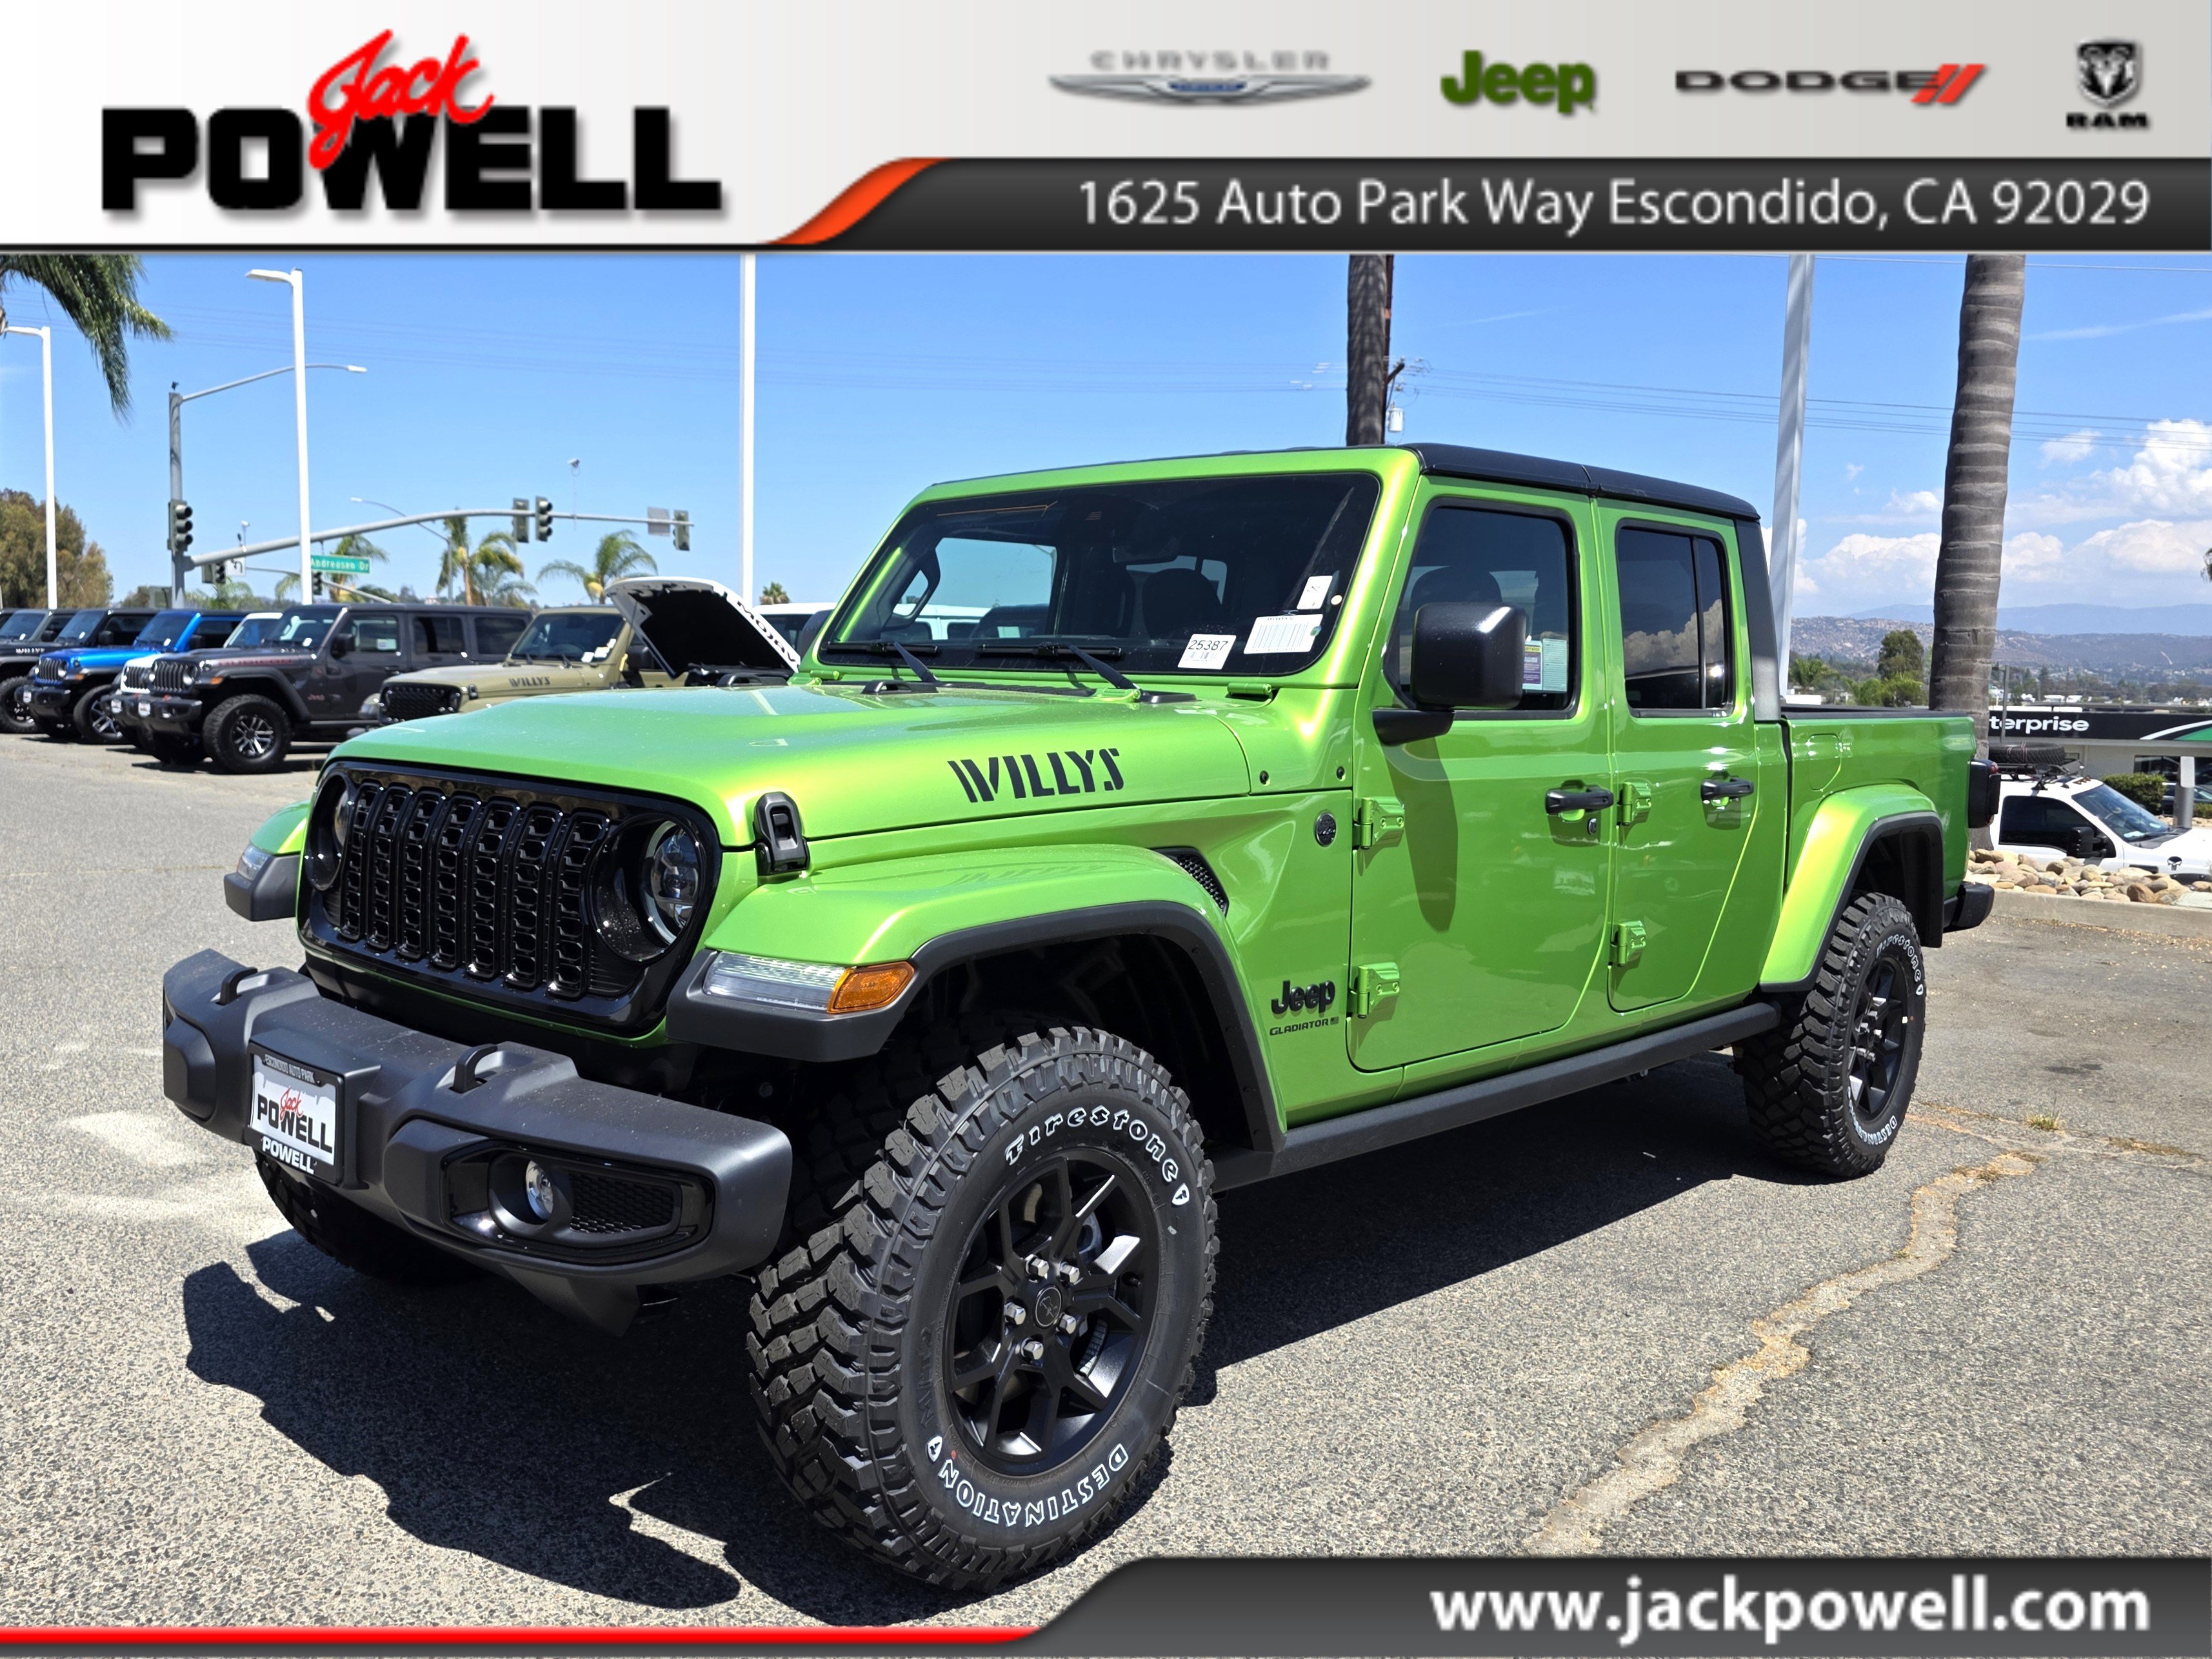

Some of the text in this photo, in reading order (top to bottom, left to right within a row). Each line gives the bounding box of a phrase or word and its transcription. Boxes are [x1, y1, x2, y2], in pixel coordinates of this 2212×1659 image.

[311, 558, 369, 570] Andreasen Dr
[737, 601, 796, 662] MOJAV
[1188, 639, 1229, 651] 25387
[508, 676, 551, 687] WILLYS
[1989, 715, 2089, 734] terprise
[946, 747, 1124, 803] WILLYS
[1876, 934, 1922, 983] Firestone
[1271, 980, 1335, 1014] Jeep
[1270, 1018, 1329, 1036] GLADIATOR
[280, 1086, 303, 1121] Jack
[257, 1094, 333, 1154] POWELL
[262, 1136, 315, 1175] POWELL
[1004, 1104, 1179, 1183] Firestone
[938, 1443, 1129, 1528] DESTINATION
